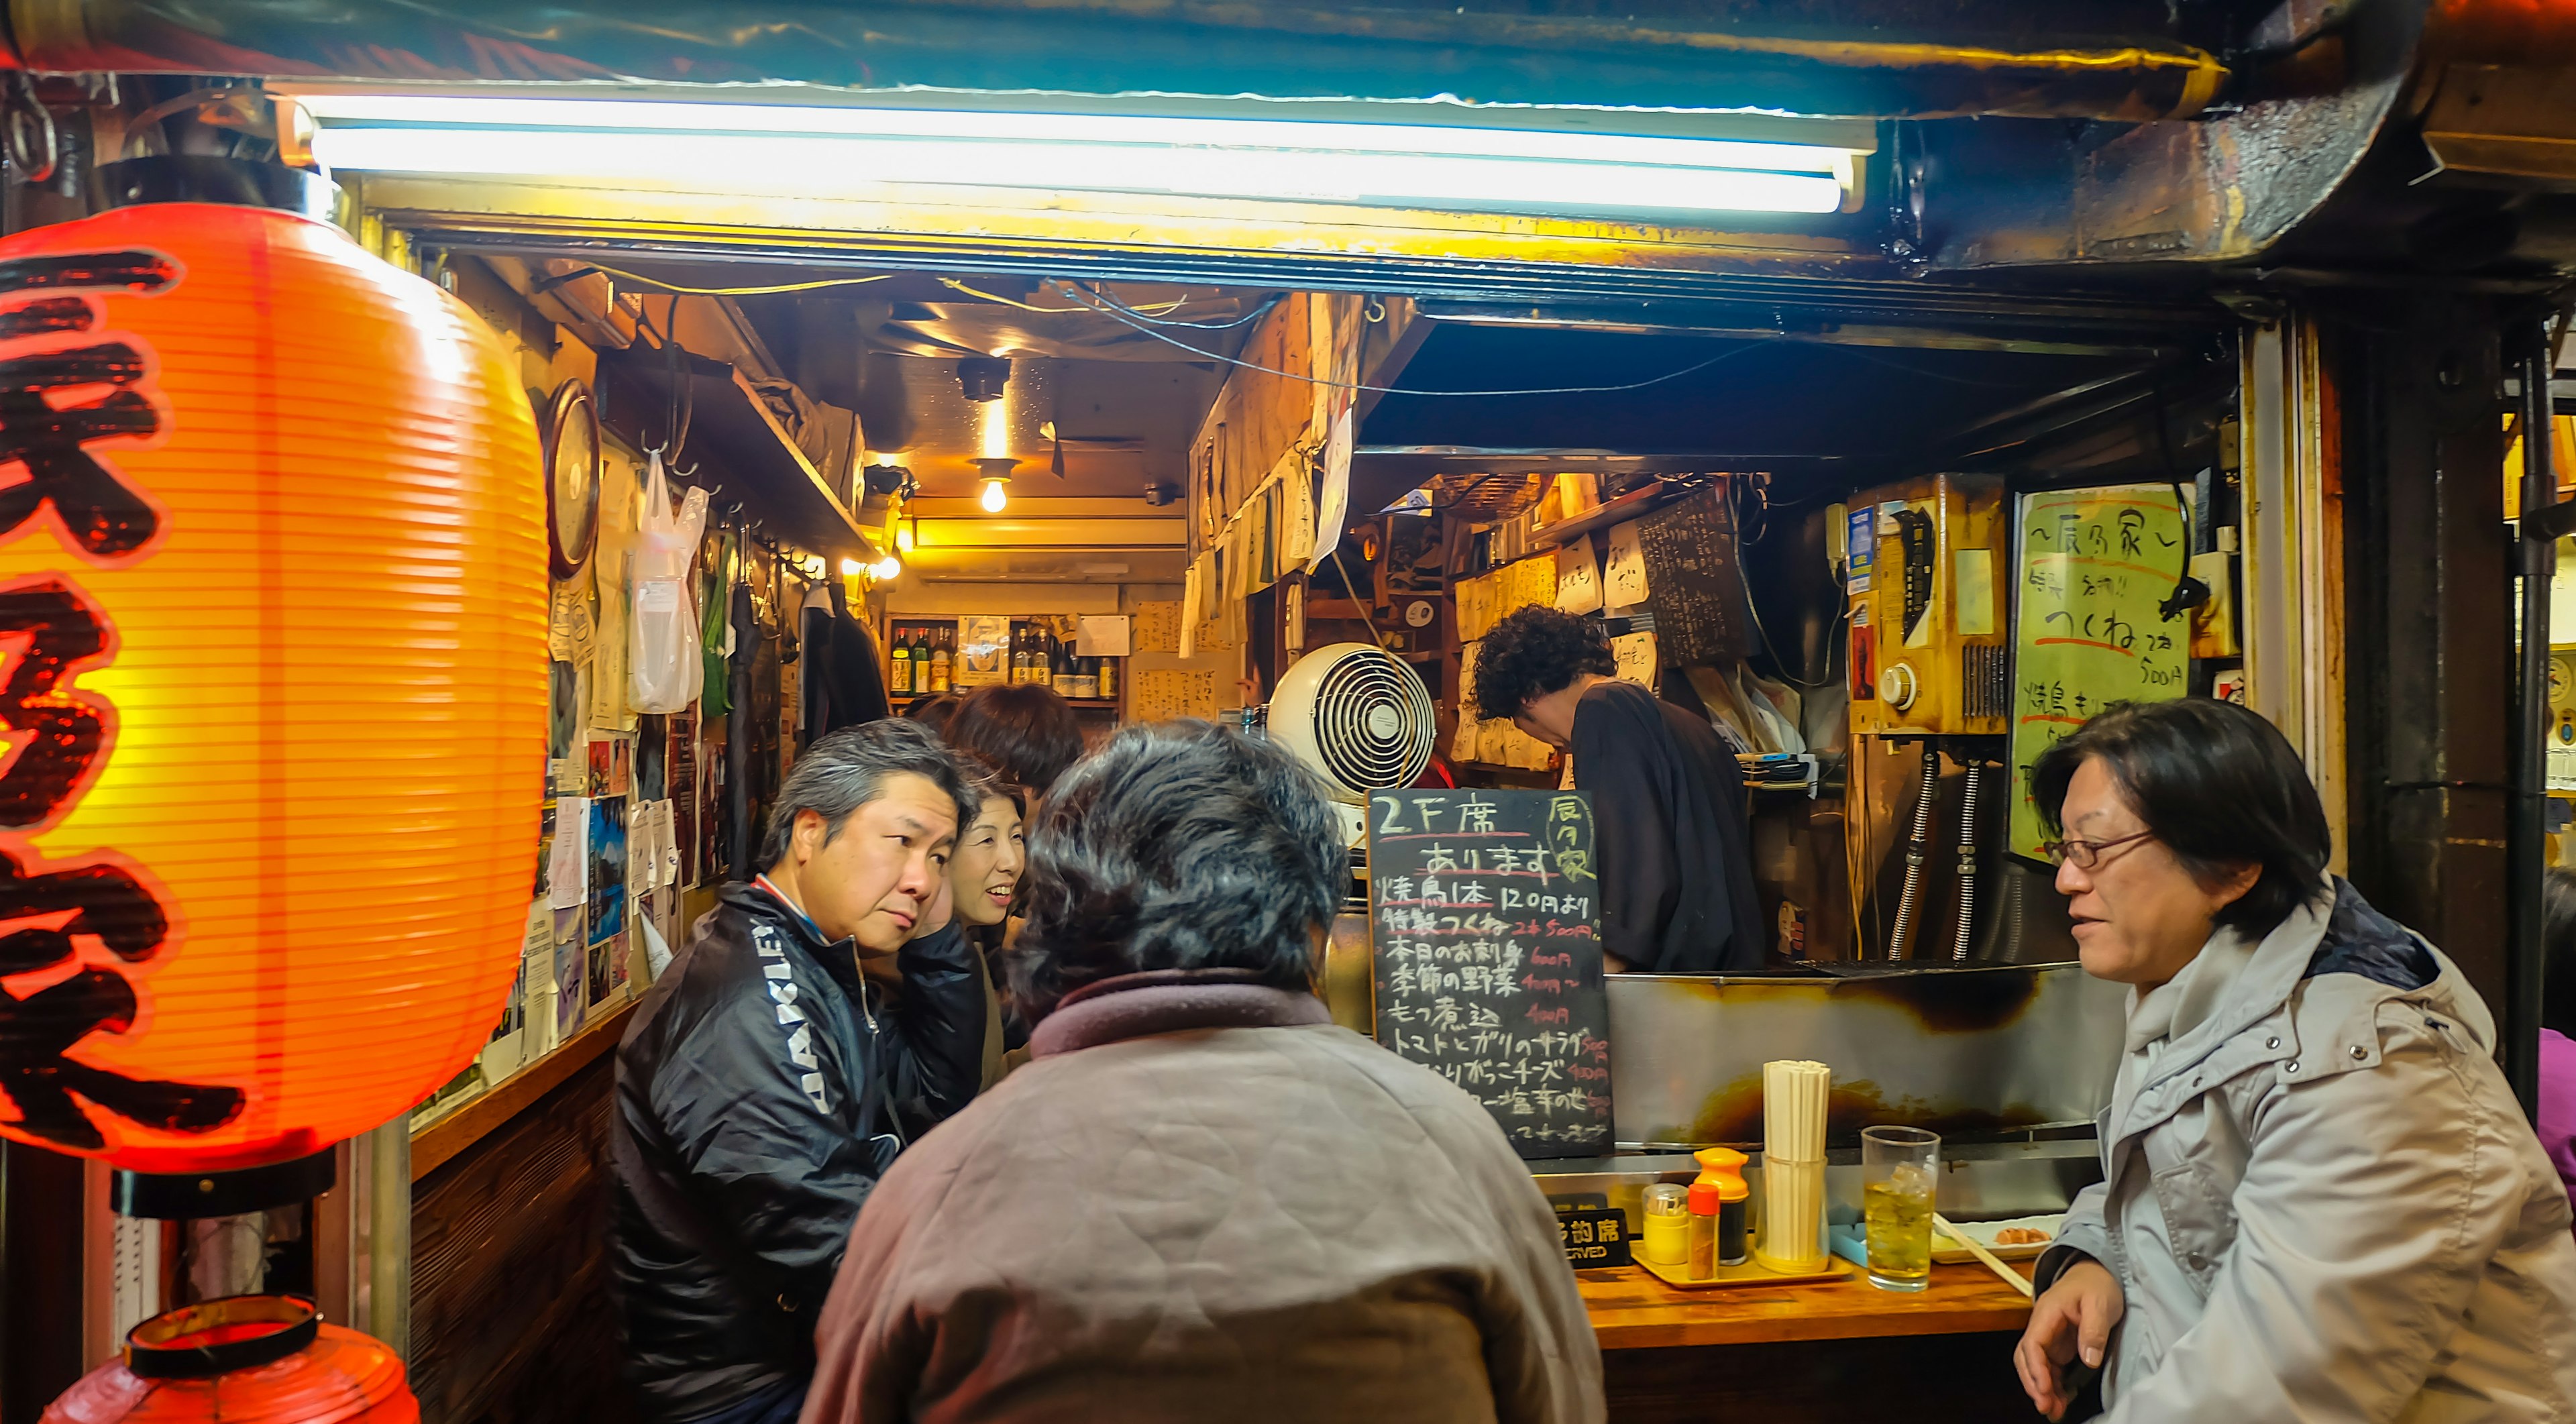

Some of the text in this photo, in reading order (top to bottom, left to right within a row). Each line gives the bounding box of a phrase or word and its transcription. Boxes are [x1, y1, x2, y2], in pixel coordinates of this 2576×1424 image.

[2045, 608, 2137, 649] つくね
[2141, 656, 2182, 685] 500円
[1372, 792, 1497, 834] 2F席
[1419, 842, 1550, 885] あります
[1375, 875, 1589, 919] 焼鳥1本 120円より
[1382, 908, 1513, 936] 特製つくね
[1386, 935, 1525, 967] 本日のお刺身
[1391, 963, 1522, 997] 季節の野菜
[1387, 996, 1503, 1032] もつ煮込
[1395, 1027, 1590, 1060] トマトとガリのサラダ
[1417, 1058, 1565, 1086] りがっこチーズ
